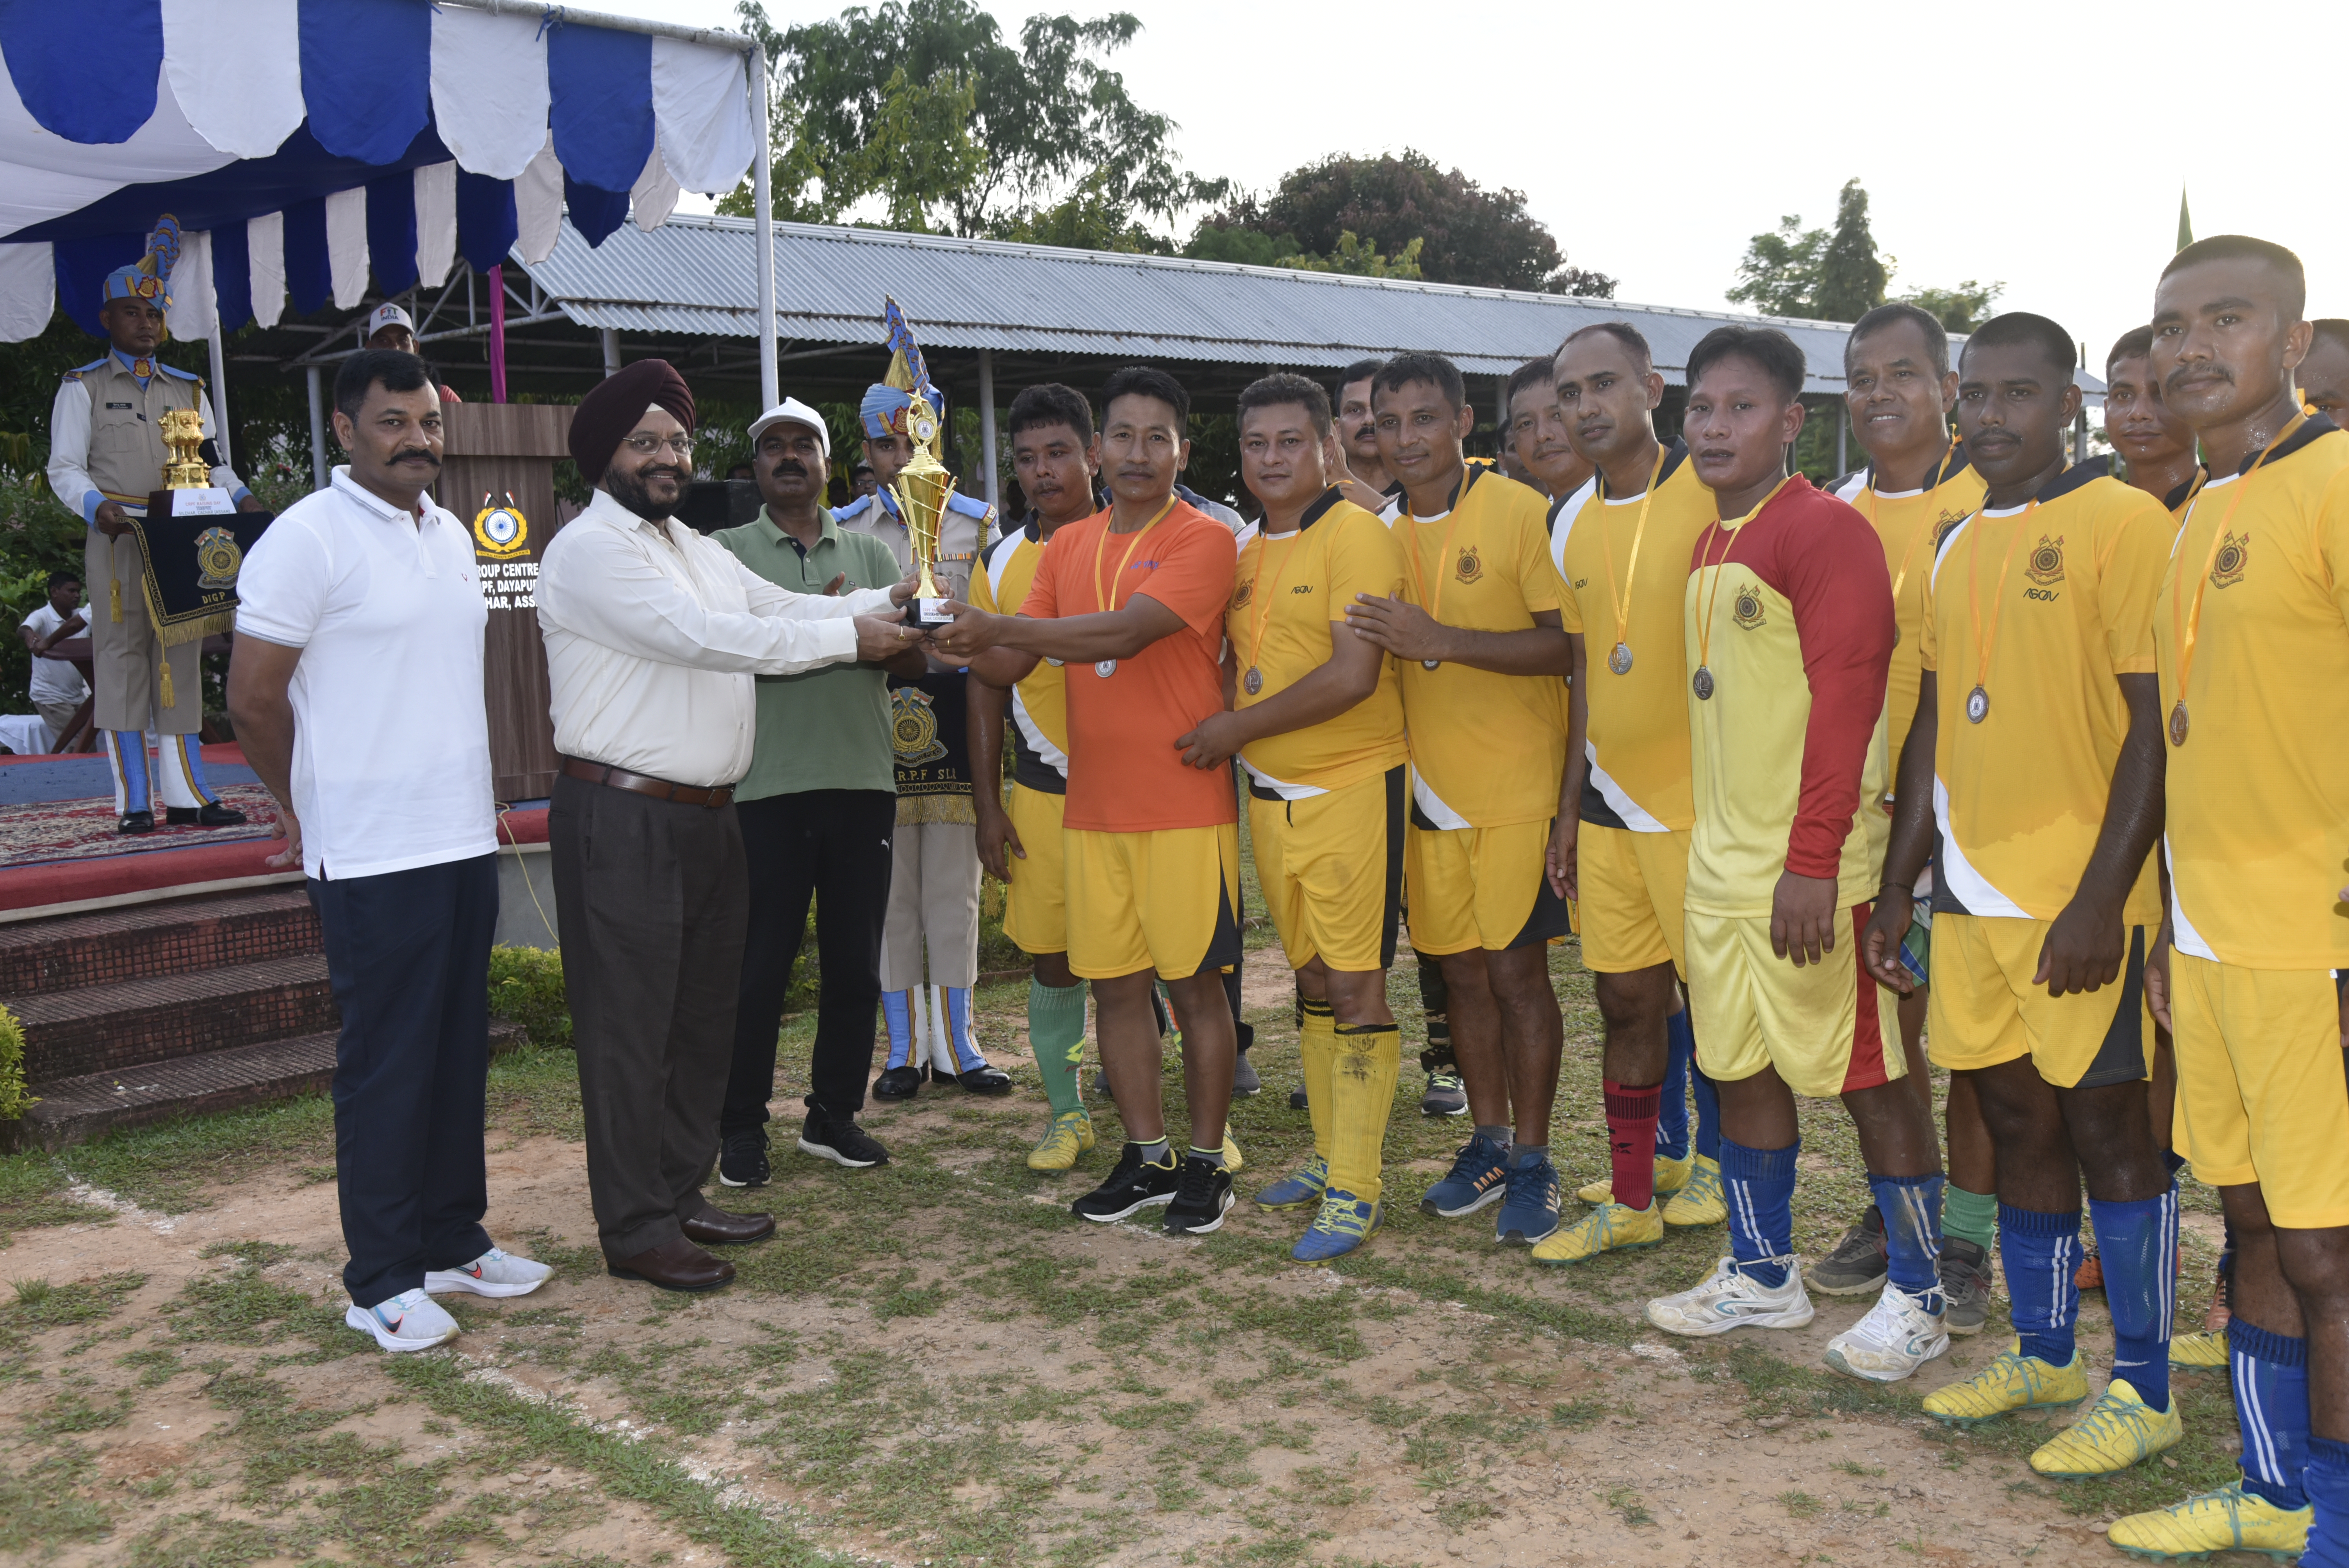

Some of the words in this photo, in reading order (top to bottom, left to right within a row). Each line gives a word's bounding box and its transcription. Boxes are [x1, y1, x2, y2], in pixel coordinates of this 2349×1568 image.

[477, 564, 500, 578] ROUP
[503, 563, 539, 577] CENTRE
[481, 581, 495, 595] PF,
[202, 592, 225, 604] DIGP
[515, 595, 538, 608] ASS
[926, 747, 942, 757] POLICE
